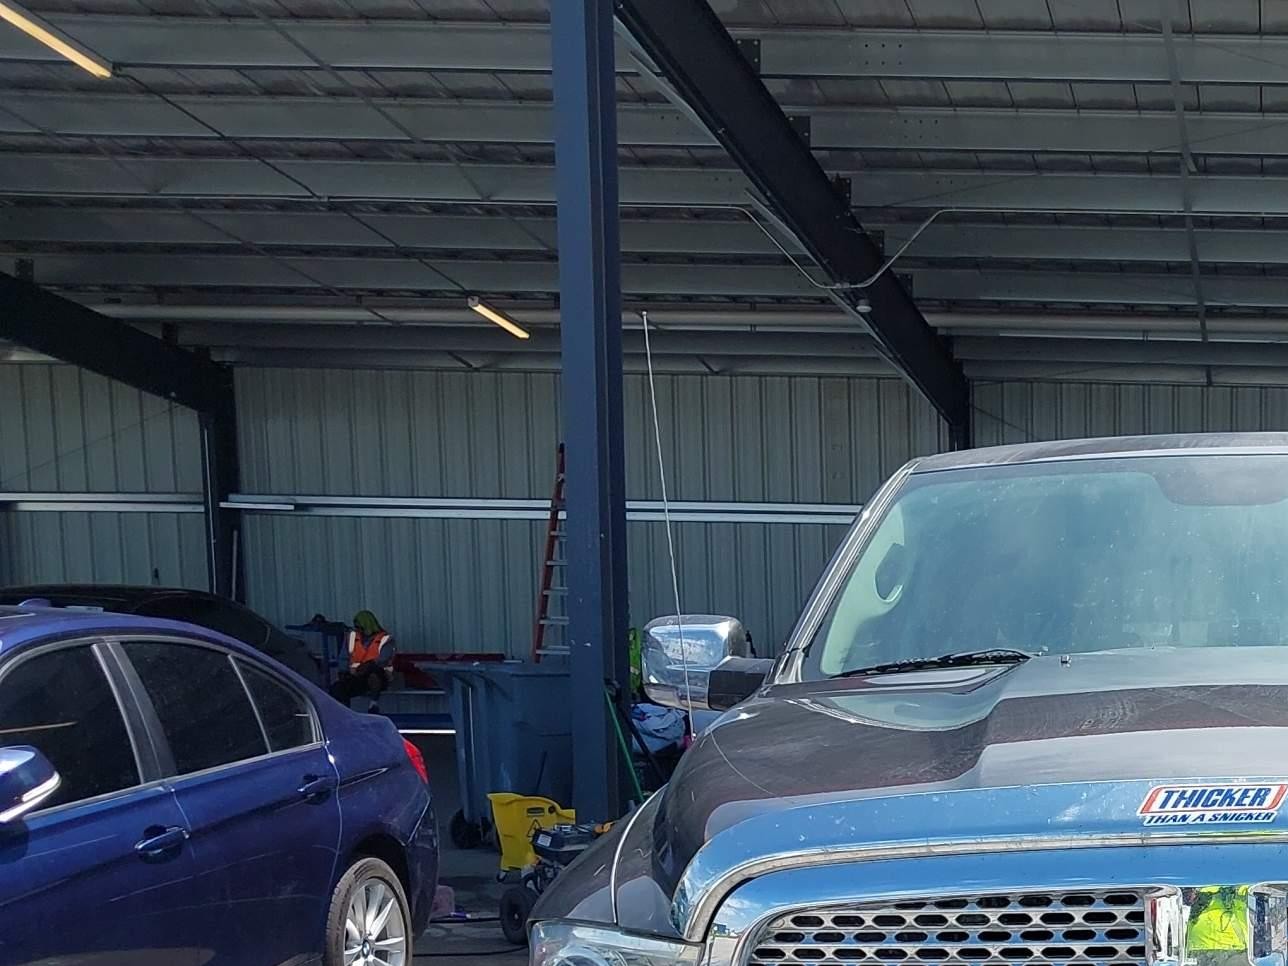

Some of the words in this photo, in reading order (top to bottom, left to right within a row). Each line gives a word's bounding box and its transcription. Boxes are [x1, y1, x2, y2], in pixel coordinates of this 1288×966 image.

[1158, 787, 1272, 810] THICKER
[1146, 814, 1191, 825] THAN
[1192, 813, 1206, 823] A
[1208, 812, 1275, 823] SNICKER
